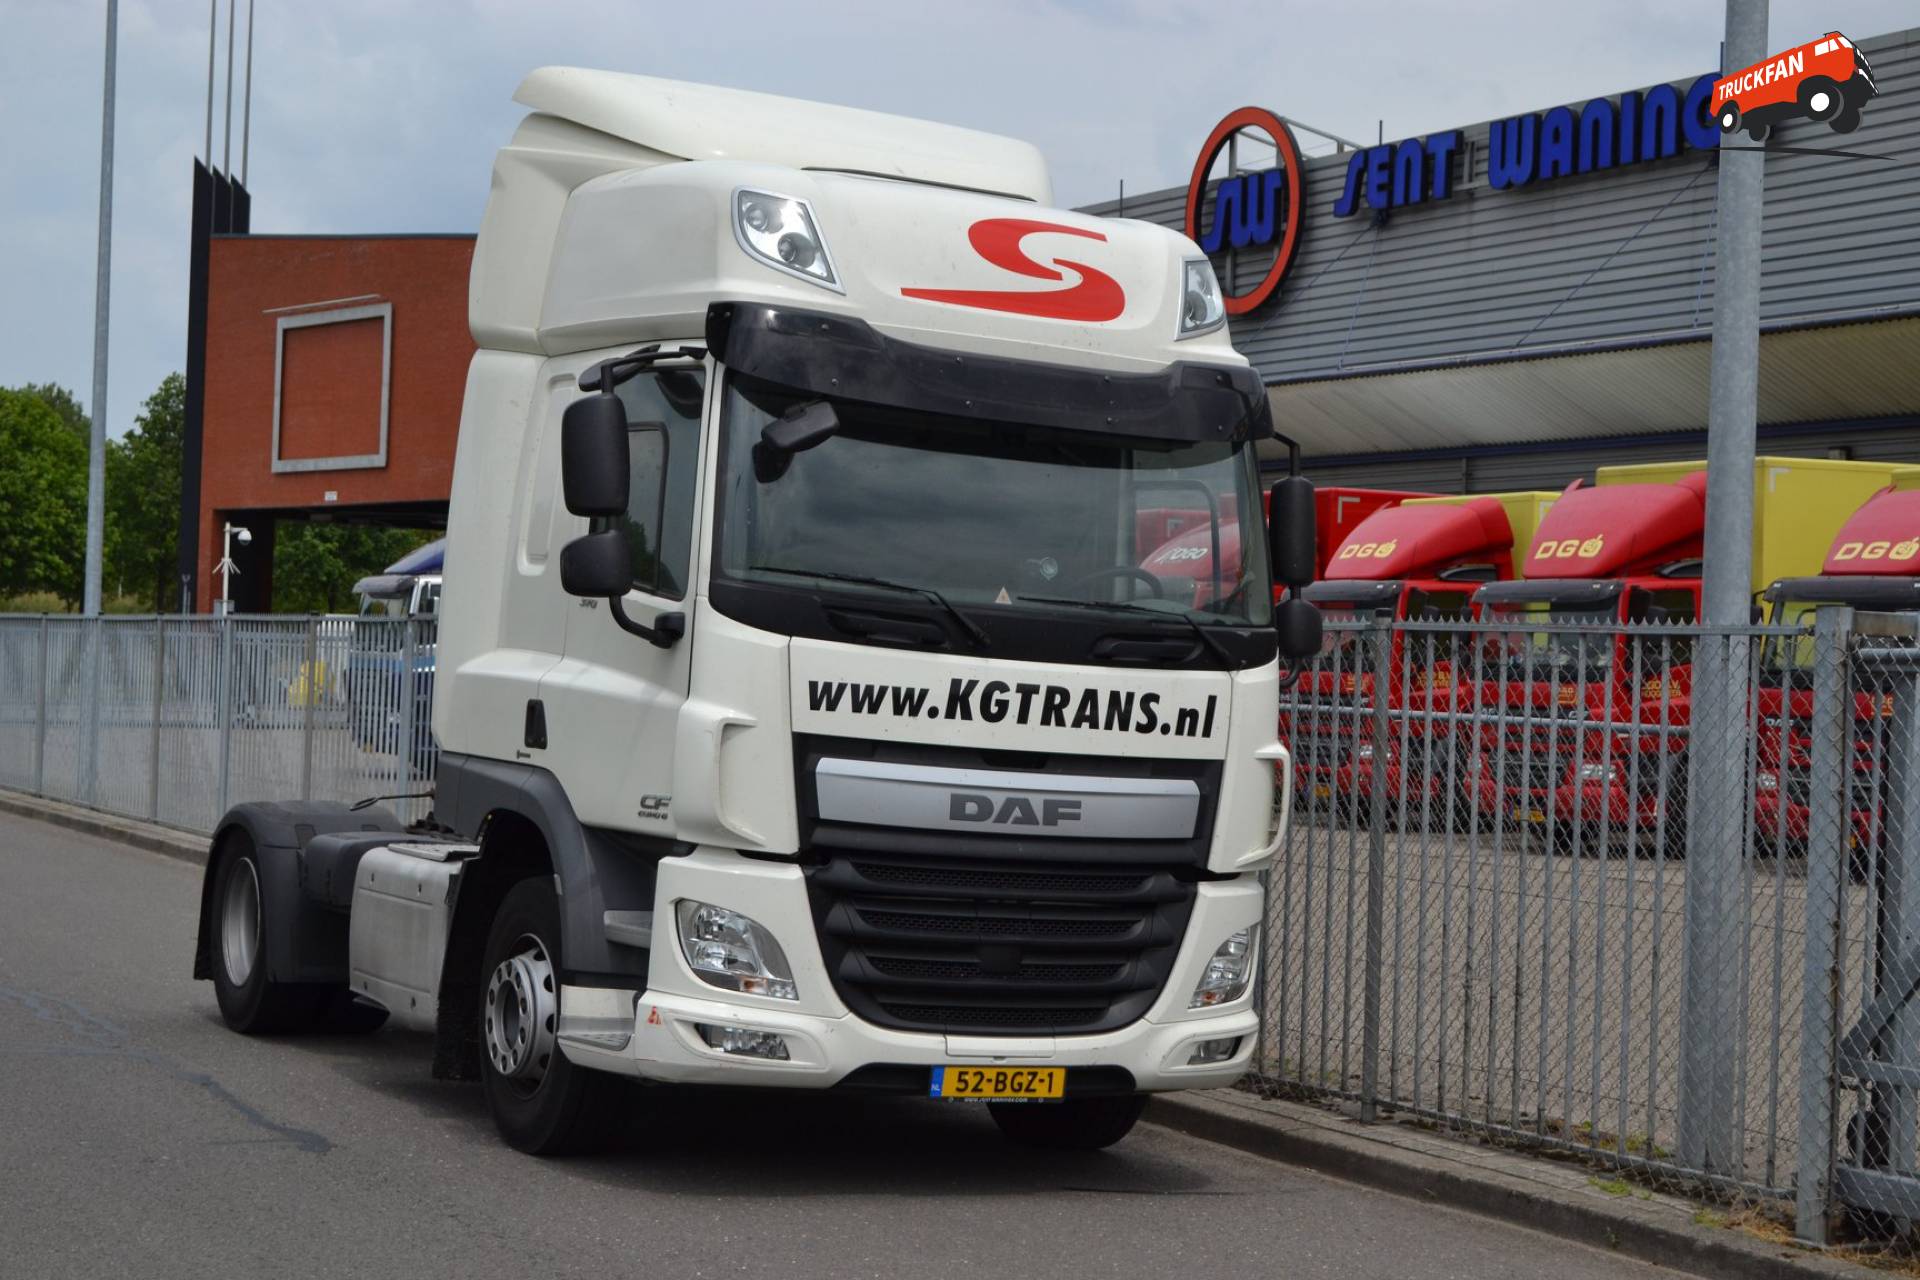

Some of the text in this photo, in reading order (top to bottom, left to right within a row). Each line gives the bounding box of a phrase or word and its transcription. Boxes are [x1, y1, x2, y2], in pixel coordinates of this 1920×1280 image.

[1333, 130, 1460, 217] SENT
[808, 678, 1218, 739] www.KGTRANS.nl
[949, 792, 1082, 827] DAF
[955, 1070, 1055, 1094] 52-BGZ-1
